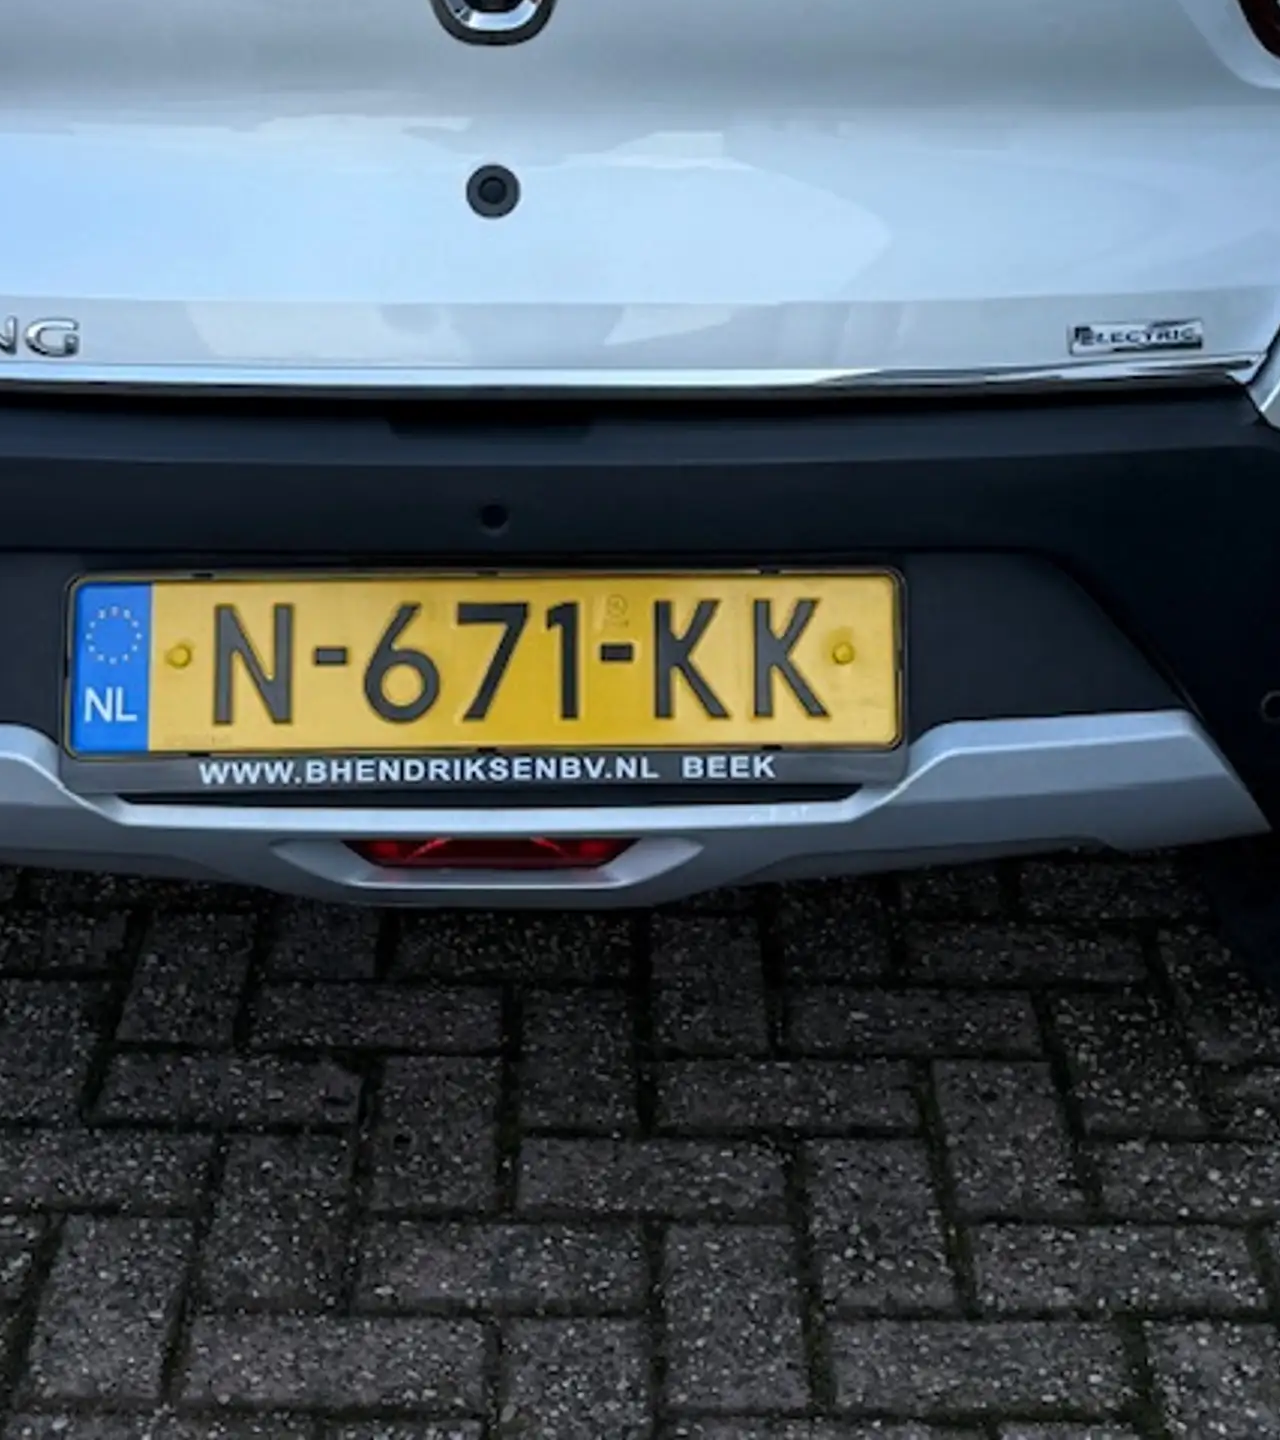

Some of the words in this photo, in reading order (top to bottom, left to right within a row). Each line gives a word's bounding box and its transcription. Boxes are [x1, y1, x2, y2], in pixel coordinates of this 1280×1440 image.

[212, 598, 832, 727] N-671-KK
[85, 686, 138, 723] NL
[198, 755, 660, 785] WWW.BHENDRIKSENBV.NL
[681, 755, 776, 779] BEEK
